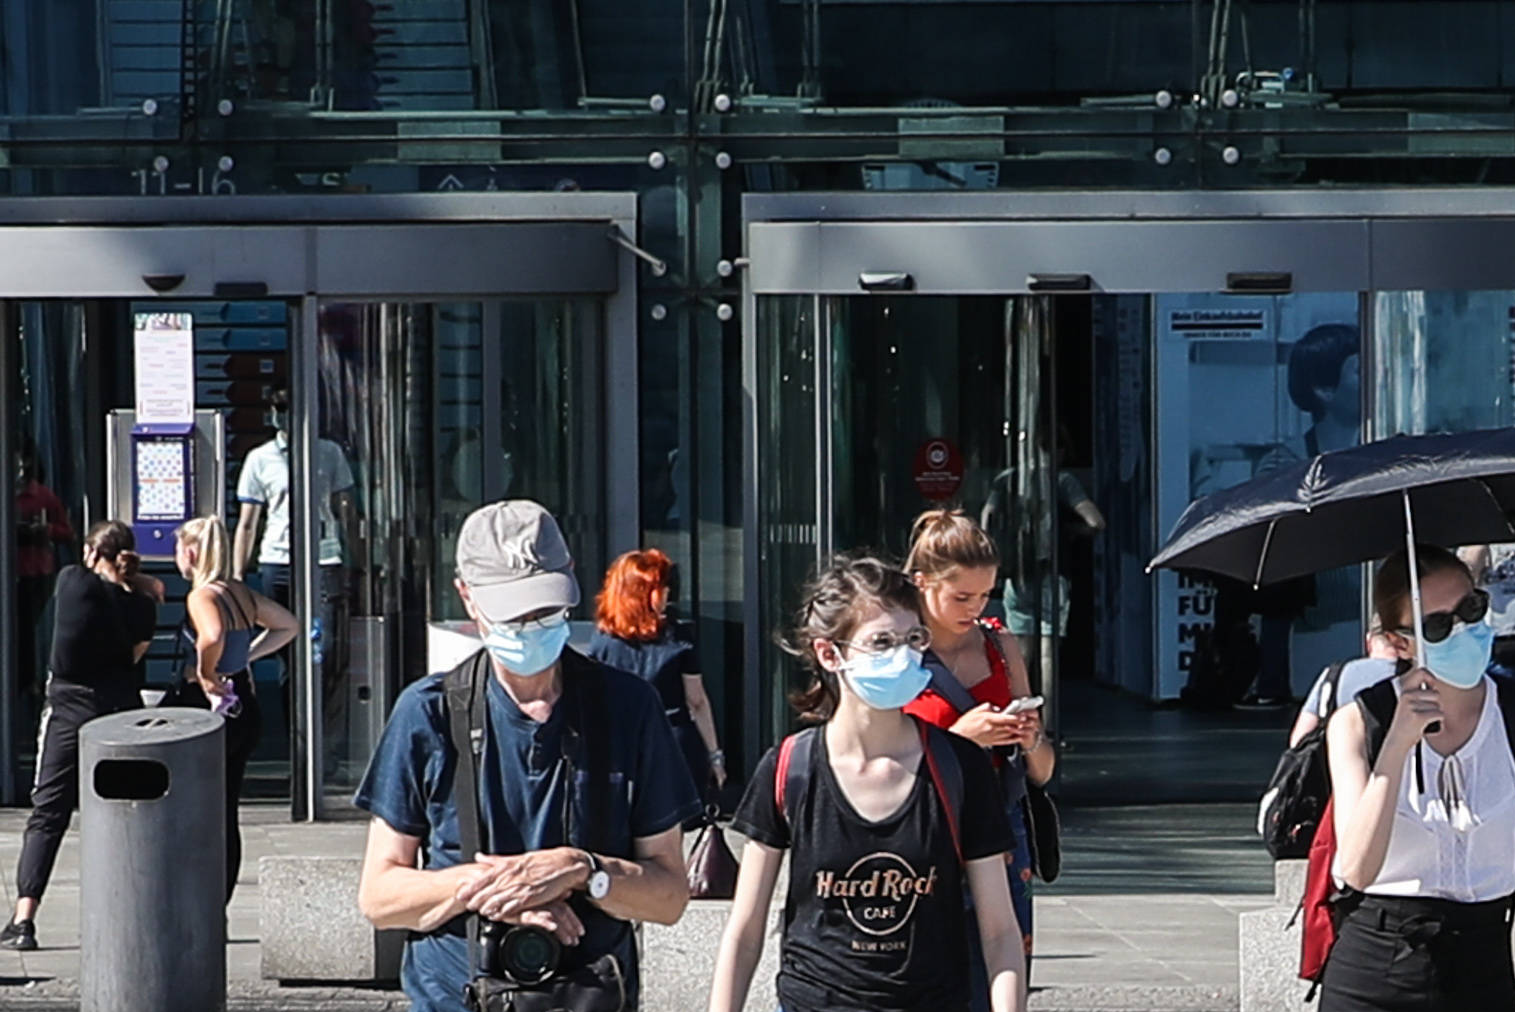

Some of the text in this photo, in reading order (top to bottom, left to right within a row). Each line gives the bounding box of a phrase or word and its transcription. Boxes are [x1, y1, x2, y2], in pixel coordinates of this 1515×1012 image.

[1178, 589, 1212, 616] FÜ
[816, 865, 938, 902] Hard Rock
[851, 940, 907, 951] NEW YORK
